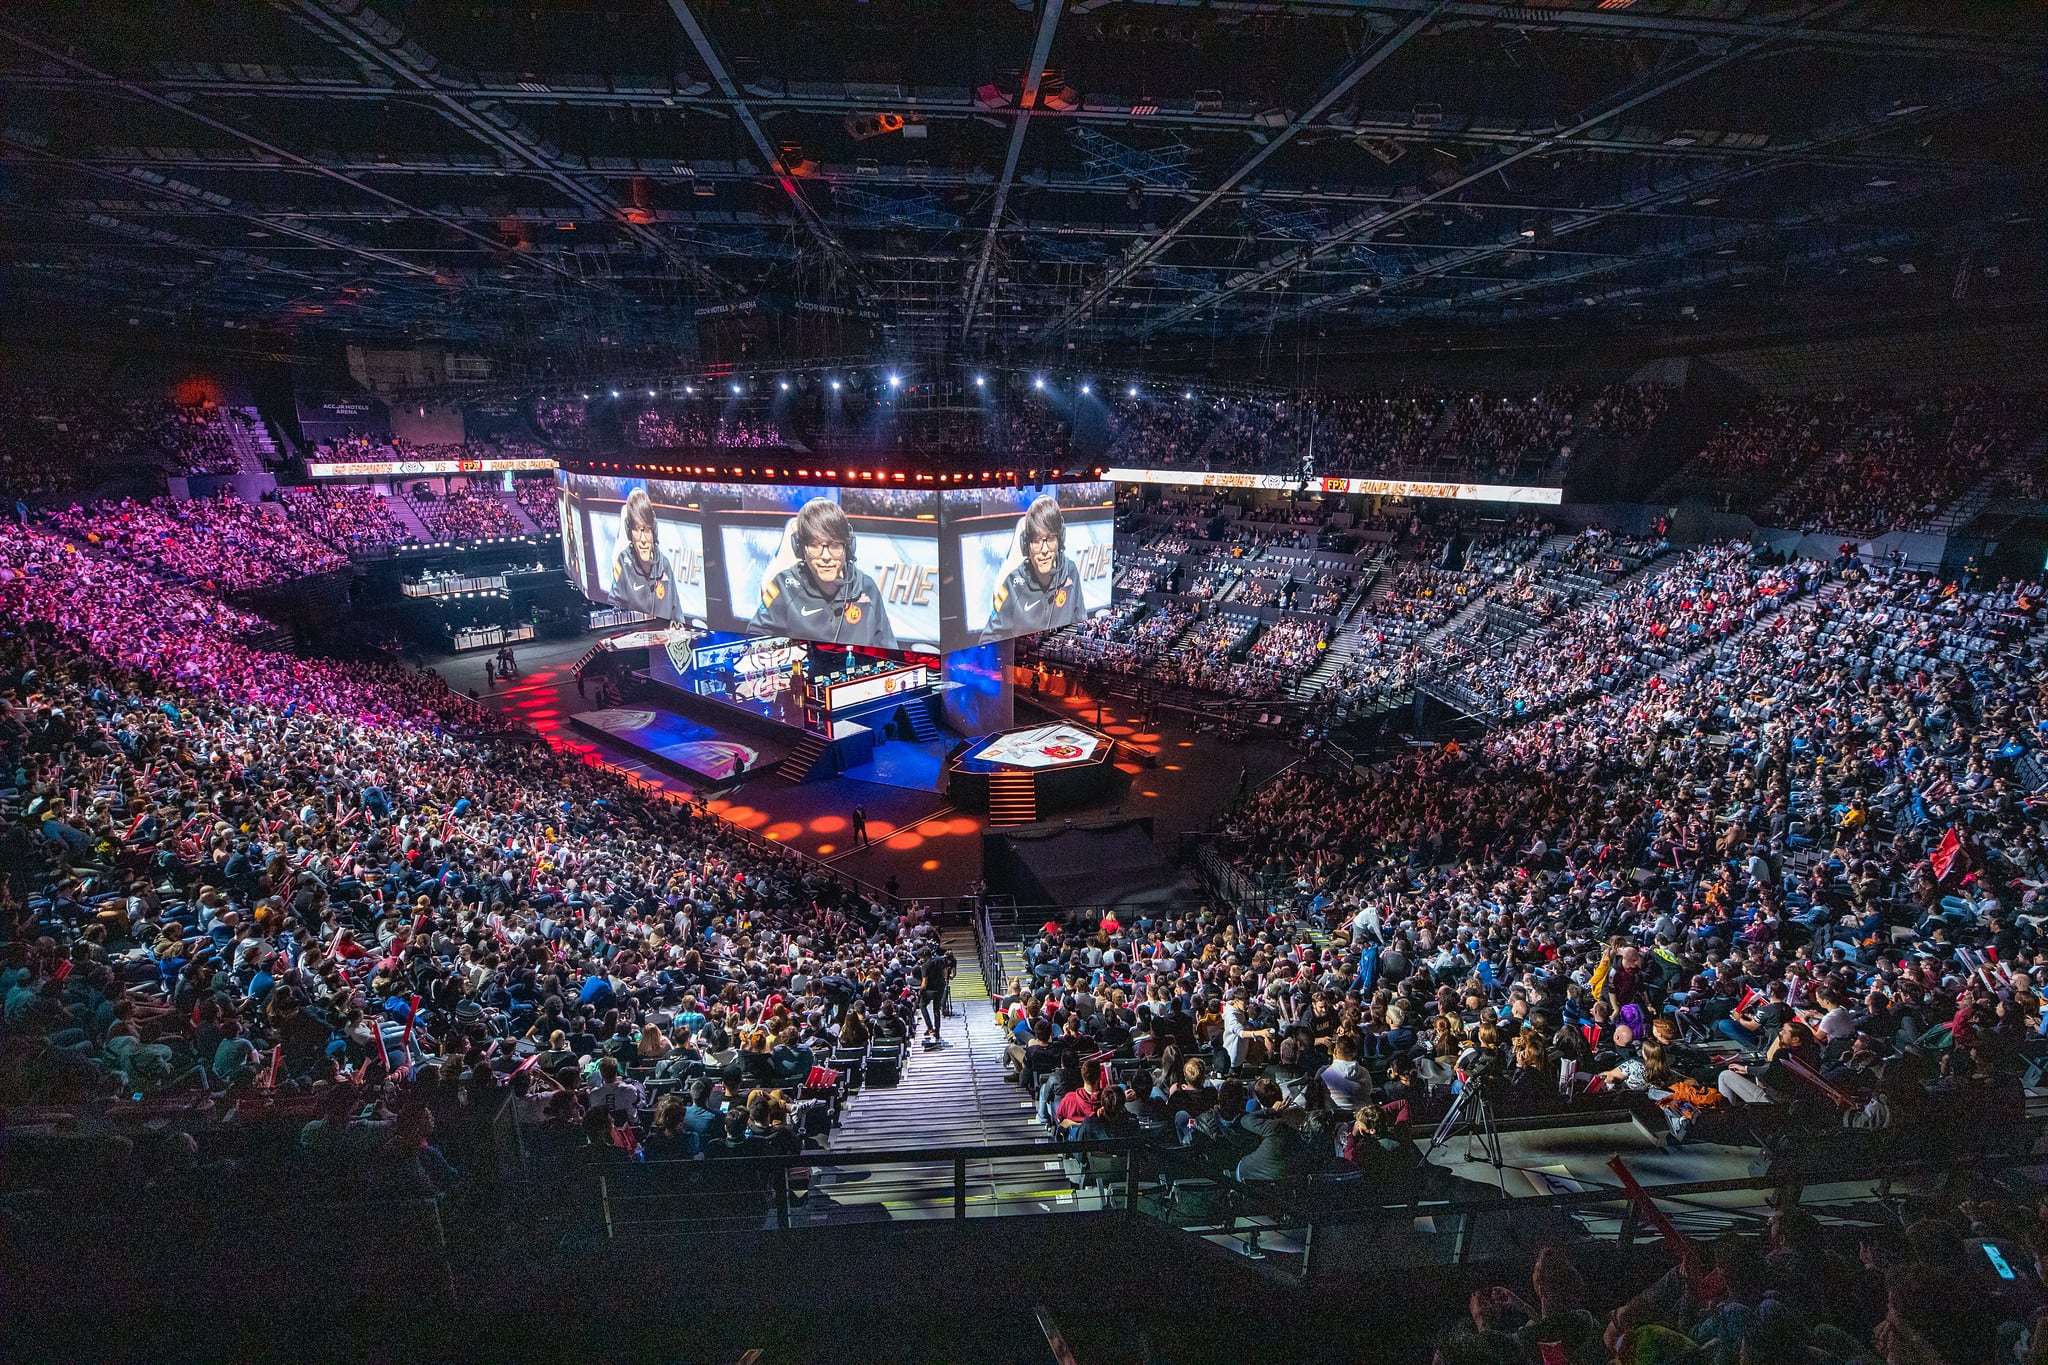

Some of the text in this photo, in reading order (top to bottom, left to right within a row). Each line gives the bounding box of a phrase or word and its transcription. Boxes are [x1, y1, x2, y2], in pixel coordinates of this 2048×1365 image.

[435, 461, 447, 472] VS
[463, 461, 479, 471] FPX
[1327, 479, 1346, 491] FPX
[668, 546, 703, 586] THE
[1076, 543, 1113, 582] THE
[874, 563, 939, 606] THE
